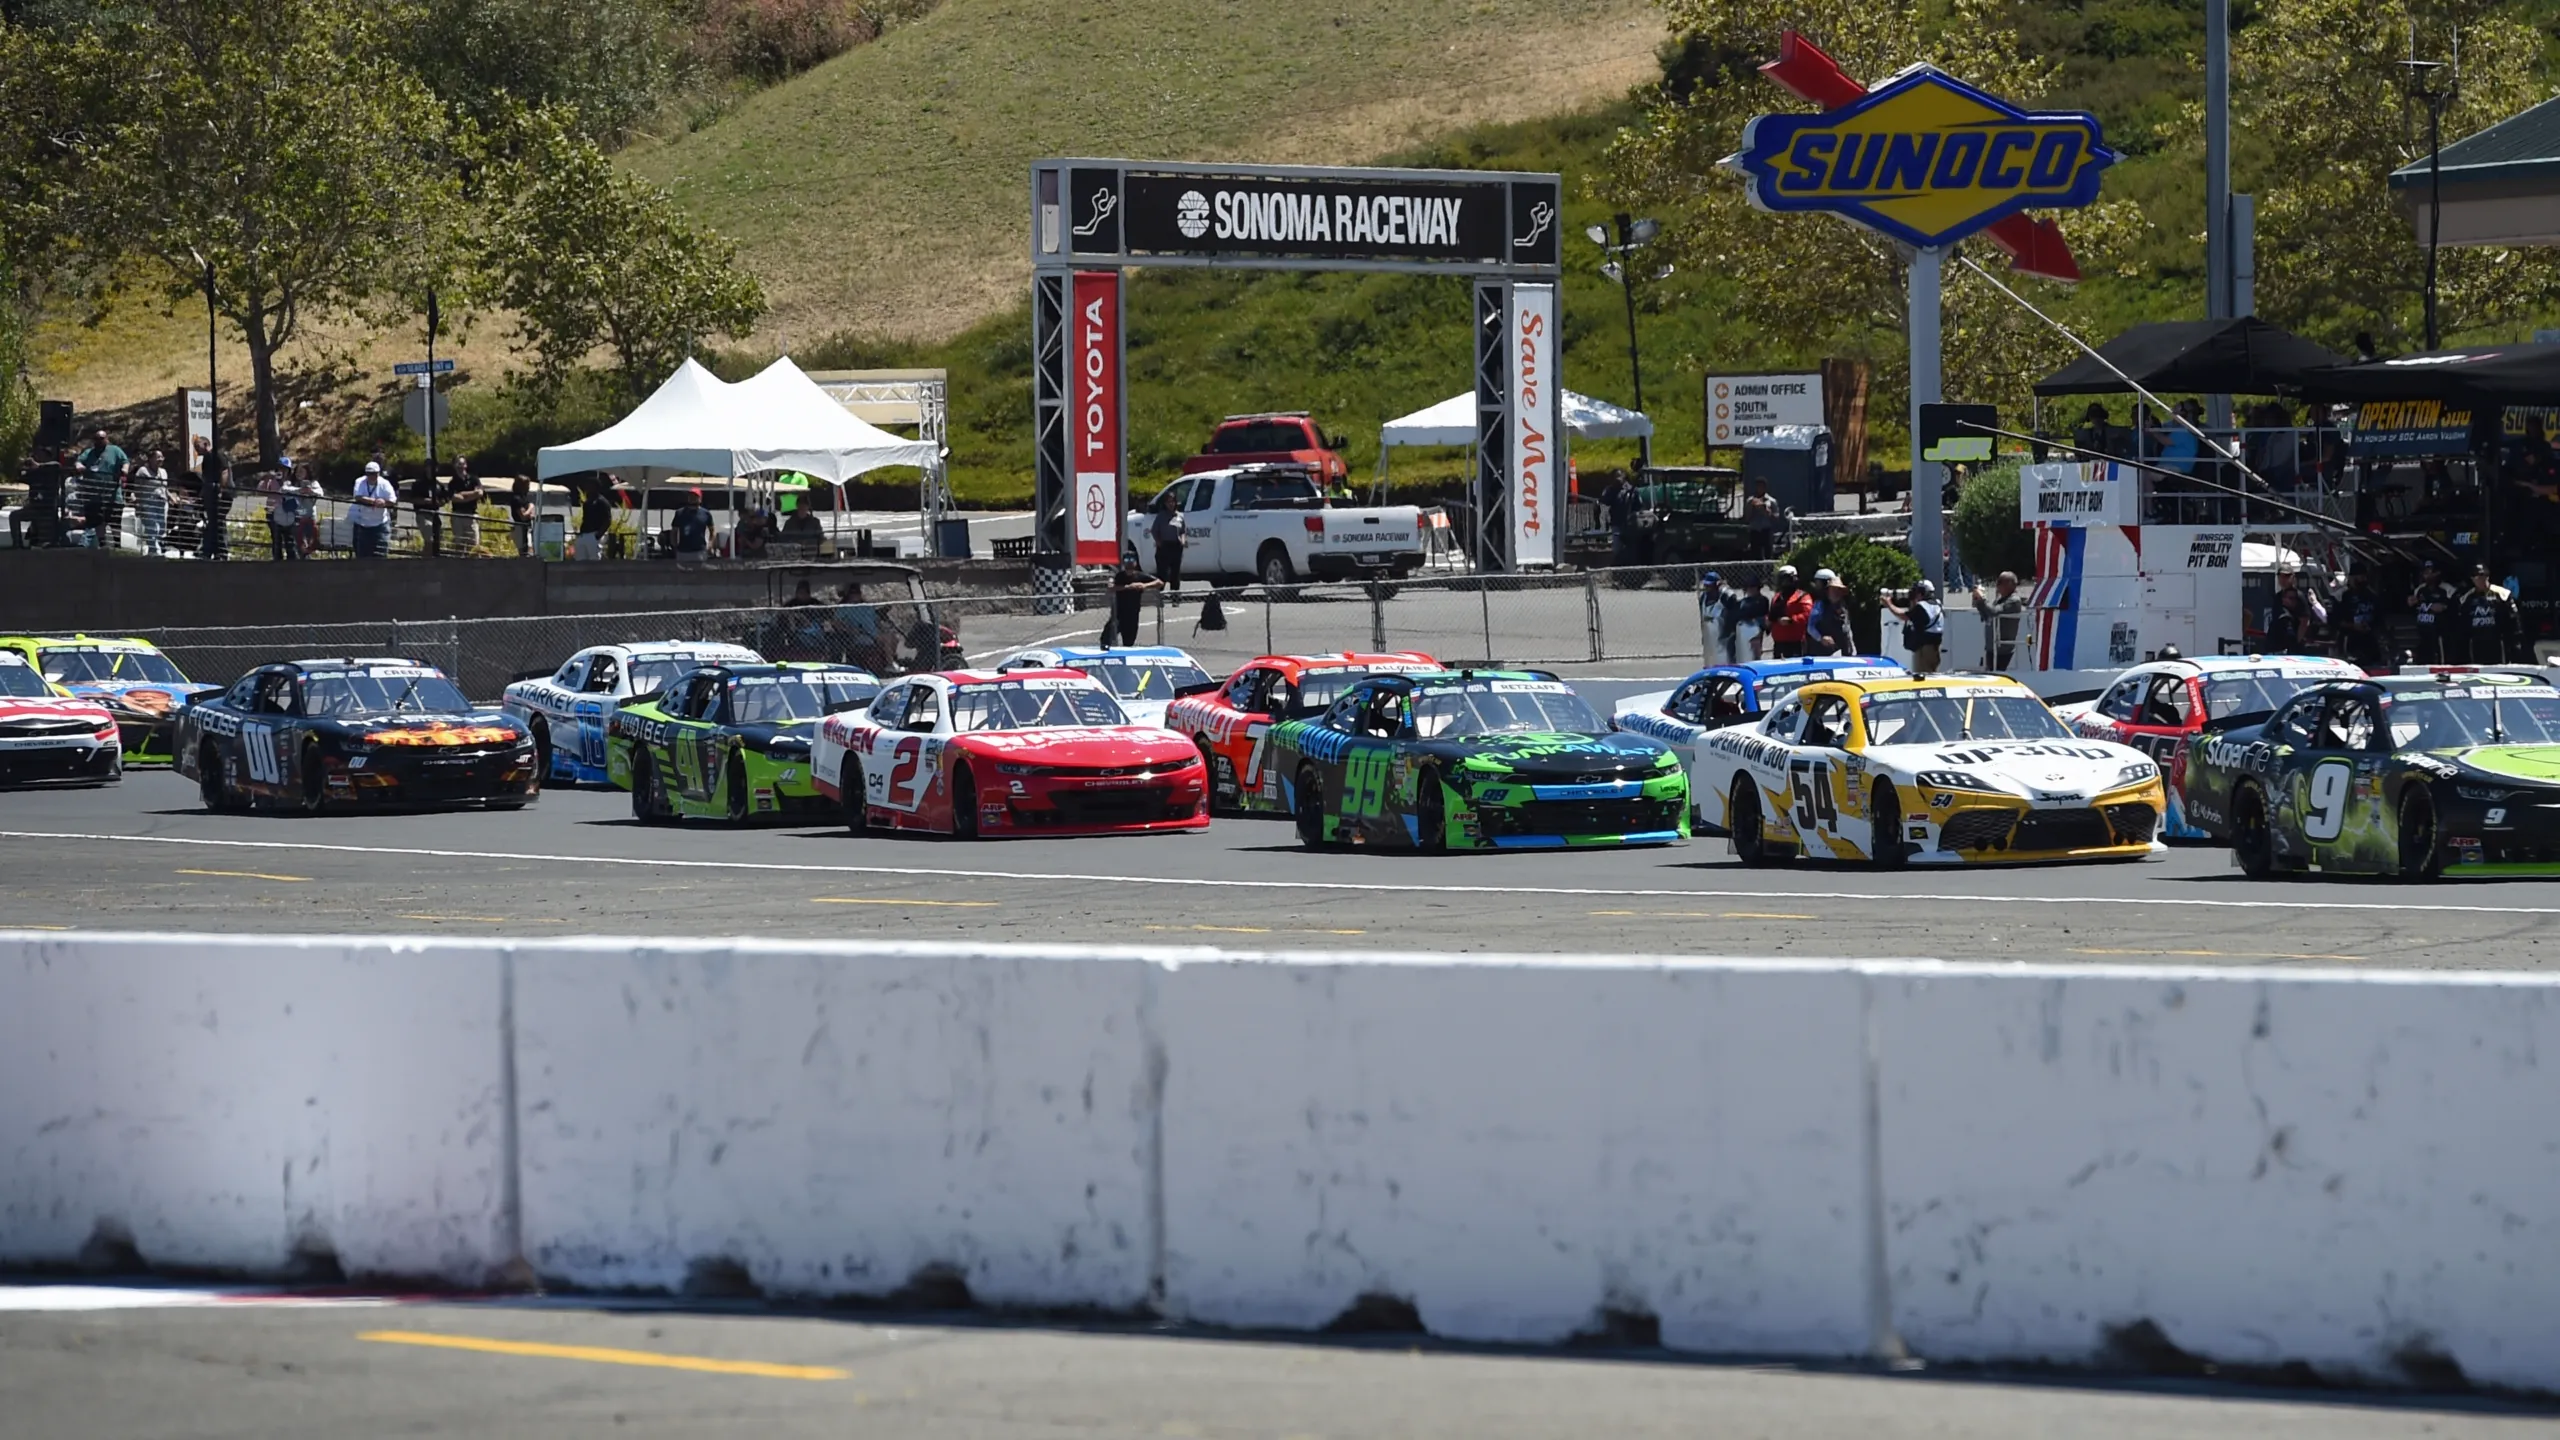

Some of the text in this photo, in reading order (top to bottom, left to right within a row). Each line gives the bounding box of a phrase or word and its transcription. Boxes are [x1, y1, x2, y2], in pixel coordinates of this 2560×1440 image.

[1780, 131, 2082, 190] SUNOCO
[1214, 190, 1463, 246] SONOMA RACEWAY
[1086, 297, 1104, 457] TOYOTA
[1735, 383, 1806, 396] ADMIN OFFICE
[1735, 401, 1768, 414] SOUTH
[2358, 400, 2441, 430] OPERATION
[1521, 309, 1545, 539] Save Mart
[2038, 490, 2104, 513] MOBILITY PIT BOX
[1342, 532, 1410, 543] SONOMA RACEWAY
[2202, 533, 2234, 542] NASCAR
[2190, 543, 2232, 553] MOBILITY
[2187, 555, 2229, 568] PIT BOX
[1145, 656, 1174, 664] HILL
[383, 668, 423, 676] CREED
[815, 674, 860, 682] MAYER
[1856, 669, 1882, 677] DAY
[1501, 683, 1556, 692] RETZLAFF
[516, 683, 577, 712] STARKEY
[1168, 698, 1246, 746] BRANDT
[619, 715, 669, 746] AUDIBEL
[823, 714, 883, 756] WHELEN
[14, 740, 69, 748] CHEVROLET
[1710, 731, 1767, 763] OPERATION
[1764, 745, 1790, 772] 300
[243, 722, 280, 785] 00
[676, 728, 704, 792] 41
[1244, 723, 1271, 786] 7
[348, 756, 368, 769] 00
[423, 758, 480, 766] CHEVROLET
[888, 736, 923, 808] 2
[868, 773, 884, 788] C4
[1009, 780, 1026, 794] 2
[1085, 779, 1145, 787] CHEVROLET
[1341, 747, 1393, 819] 99
[1560, 788, 1625, 797] CHEVROLET
[1789, 759, 1838, 833] 54
[2036, 792, 2086, 805] Supra
[1930, 793, 1955, 809] 54
[2305, 763, 2351, 839] 9
[2483, 808, 2507, 824] 9
